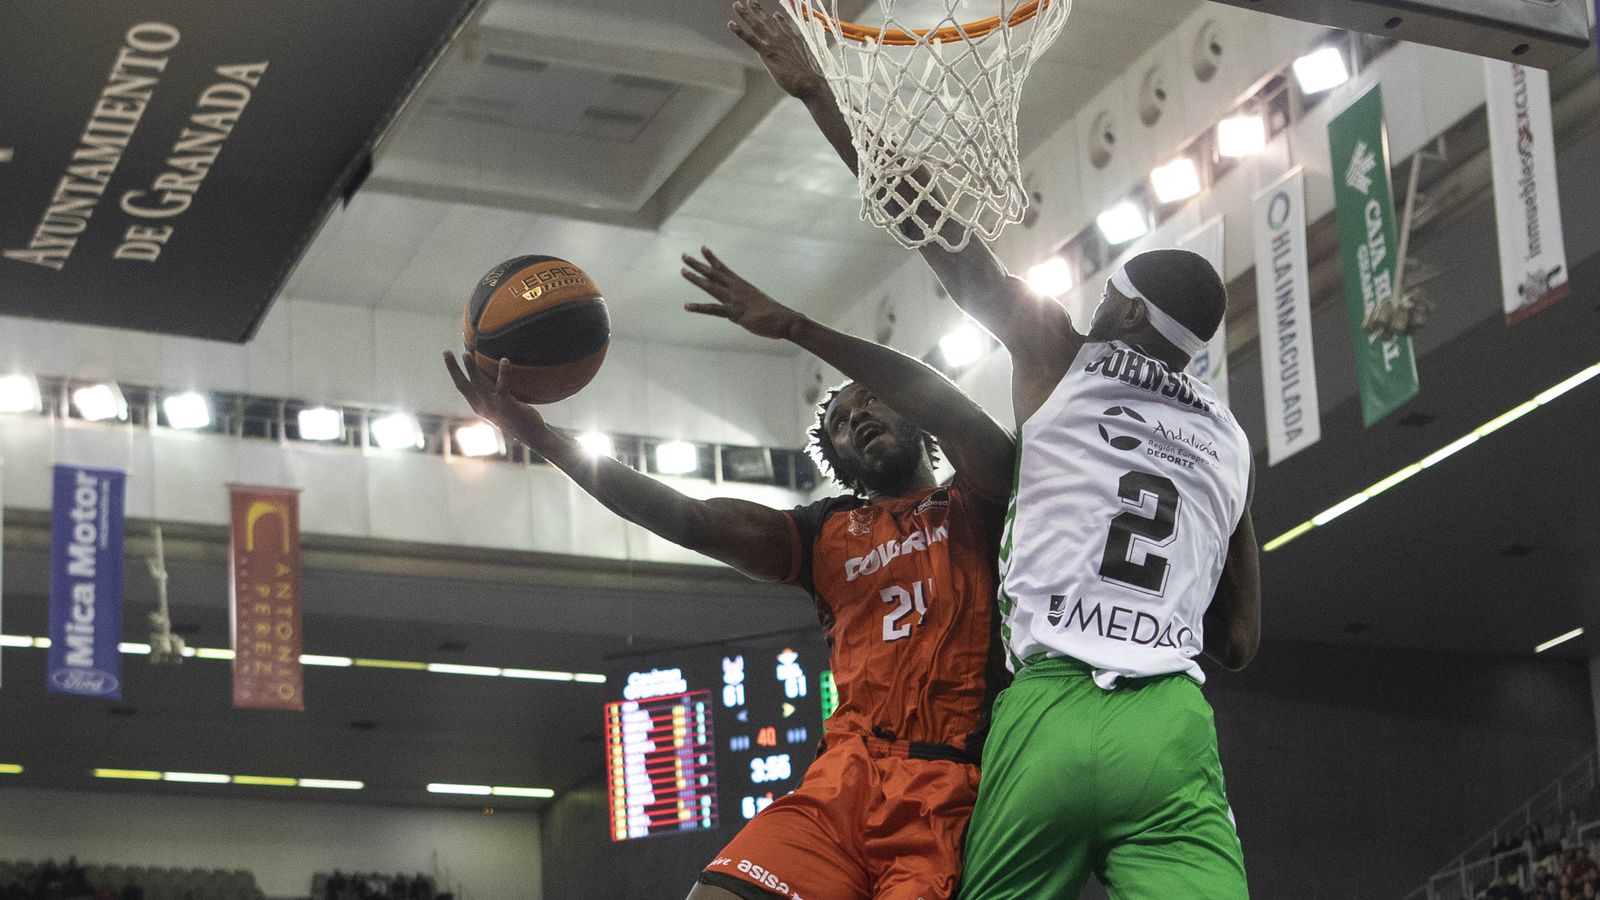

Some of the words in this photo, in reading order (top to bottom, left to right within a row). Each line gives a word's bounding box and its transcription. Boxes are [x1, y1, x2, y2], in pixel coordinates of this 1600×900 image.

[2, 22, 181, 270] AYUNTAMIENTO
[120, 61, 270, 219] GRANADA
[113, 225, 174, 262] DE
[1364, 199, 1387, 272] CAJA
[1085, 349, 1211, 415] JOHNSO
[1146, 448, 1195, 470] DEPORTE
[1152, 419, 1221, 463] Andalucía
[67, 470, 99, 577] Motor
[1098, 470, 1182, 598] 2
[66, 583, 96, 668] Mica
[275, 562, 295, 701] ANTONIO
